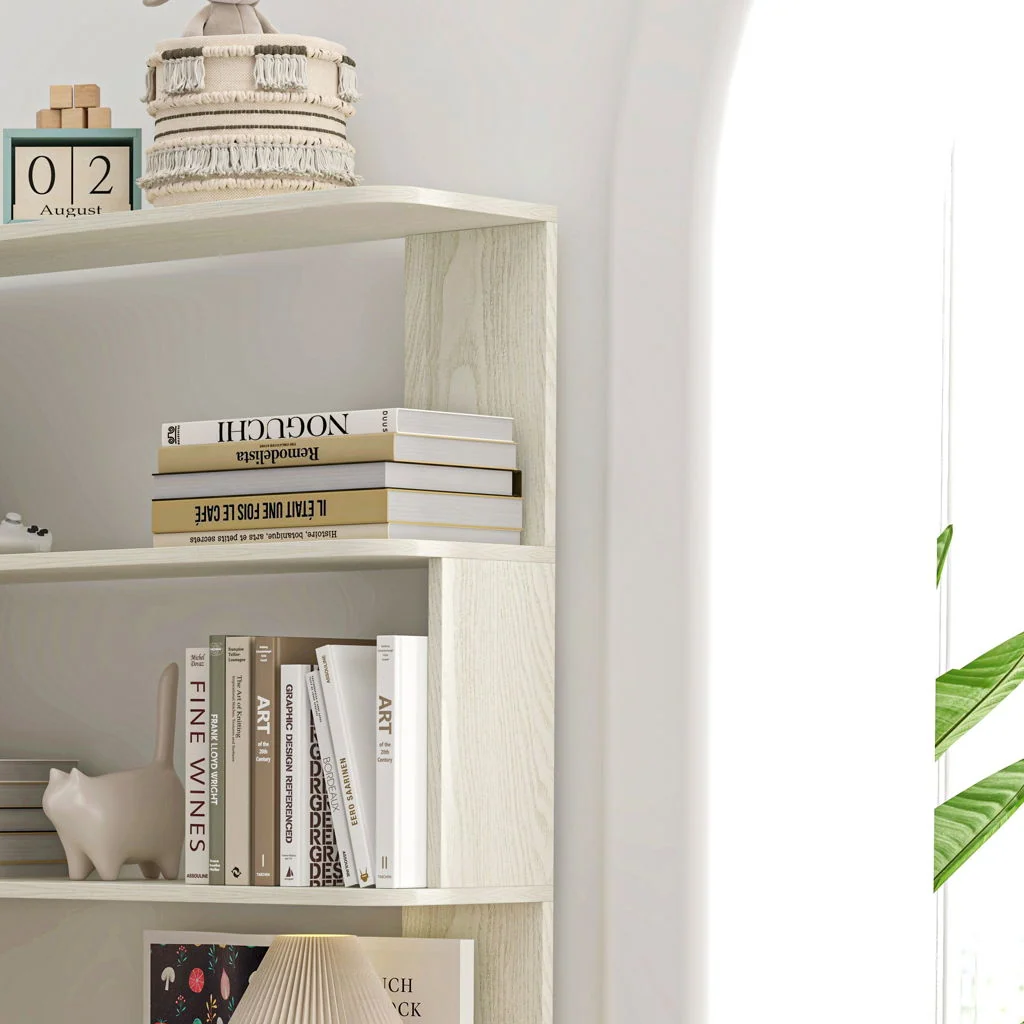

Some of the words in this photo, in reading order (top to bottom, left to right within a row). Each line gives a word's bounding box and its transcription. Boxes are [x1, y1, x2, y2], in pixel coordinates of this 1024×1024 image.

[40, 204, 102, 217] August
[218, 413, 349, 442] NOGUCHI
[236, 447, 319, 464] Remodelista
[195, 505, 220, 525] CAFÉ
[223, 504, 234, 521] LE
[238, 503, 259, 520] FOIS
[263, 502, 282, 519] UNE
[286, 500, 314, 520] ÉTAIT
[318, 500, 326, 516] IL
[218, 534, 238, 542] petits
[190, 681, 205, 743] FINE
[285, 684, 293, 730] GRAPHIC
[285, 734, 293, 772] DESIGN
[190, 758, 205, 851] WINES
[285, 776, 293, 843] REFERENCED
